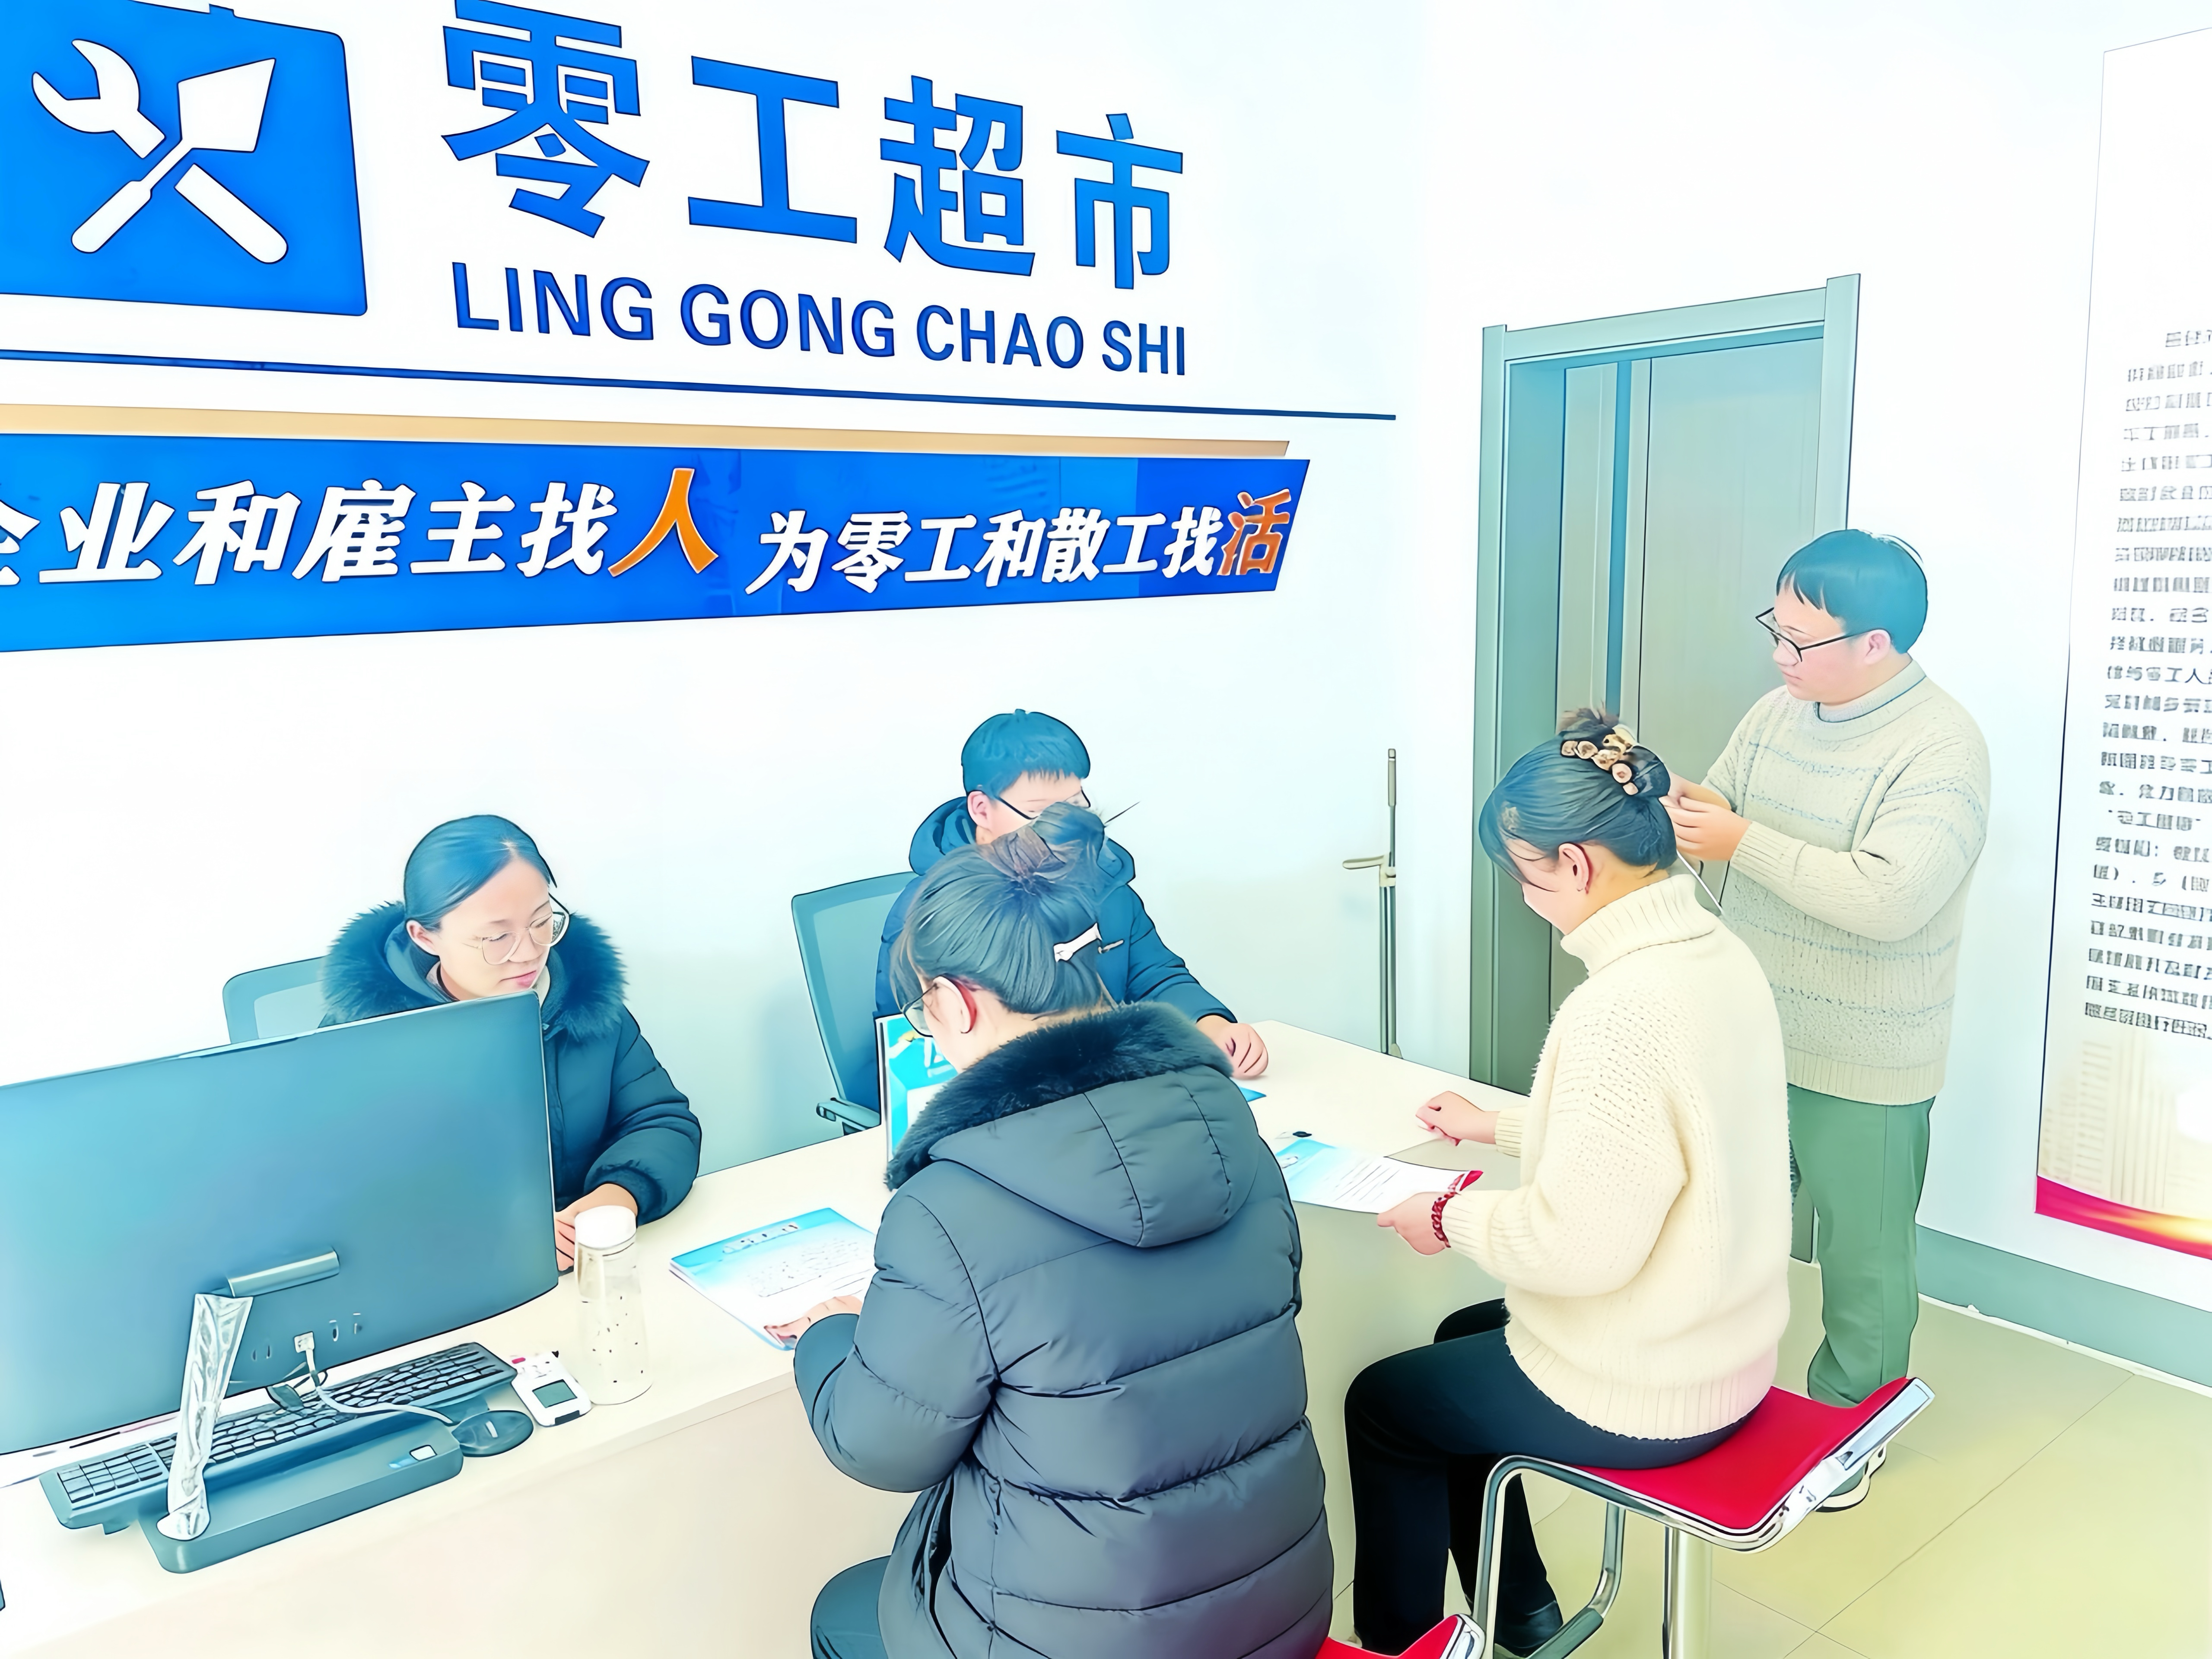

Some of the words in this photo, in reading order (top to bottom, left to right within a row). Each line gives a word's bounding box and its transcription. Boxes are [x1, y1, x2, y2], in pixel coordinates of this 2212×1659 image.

[441, 0, 1183, 289] 零工超市
[452, 262, 654, 340] LING
[680, 284, 894, 357] GONG
[917, 305, 1084, 369] CHAO
[1102, 321, 1185, 375] SHI
[746, 489, 1291, 594] 为零工和散工找活
